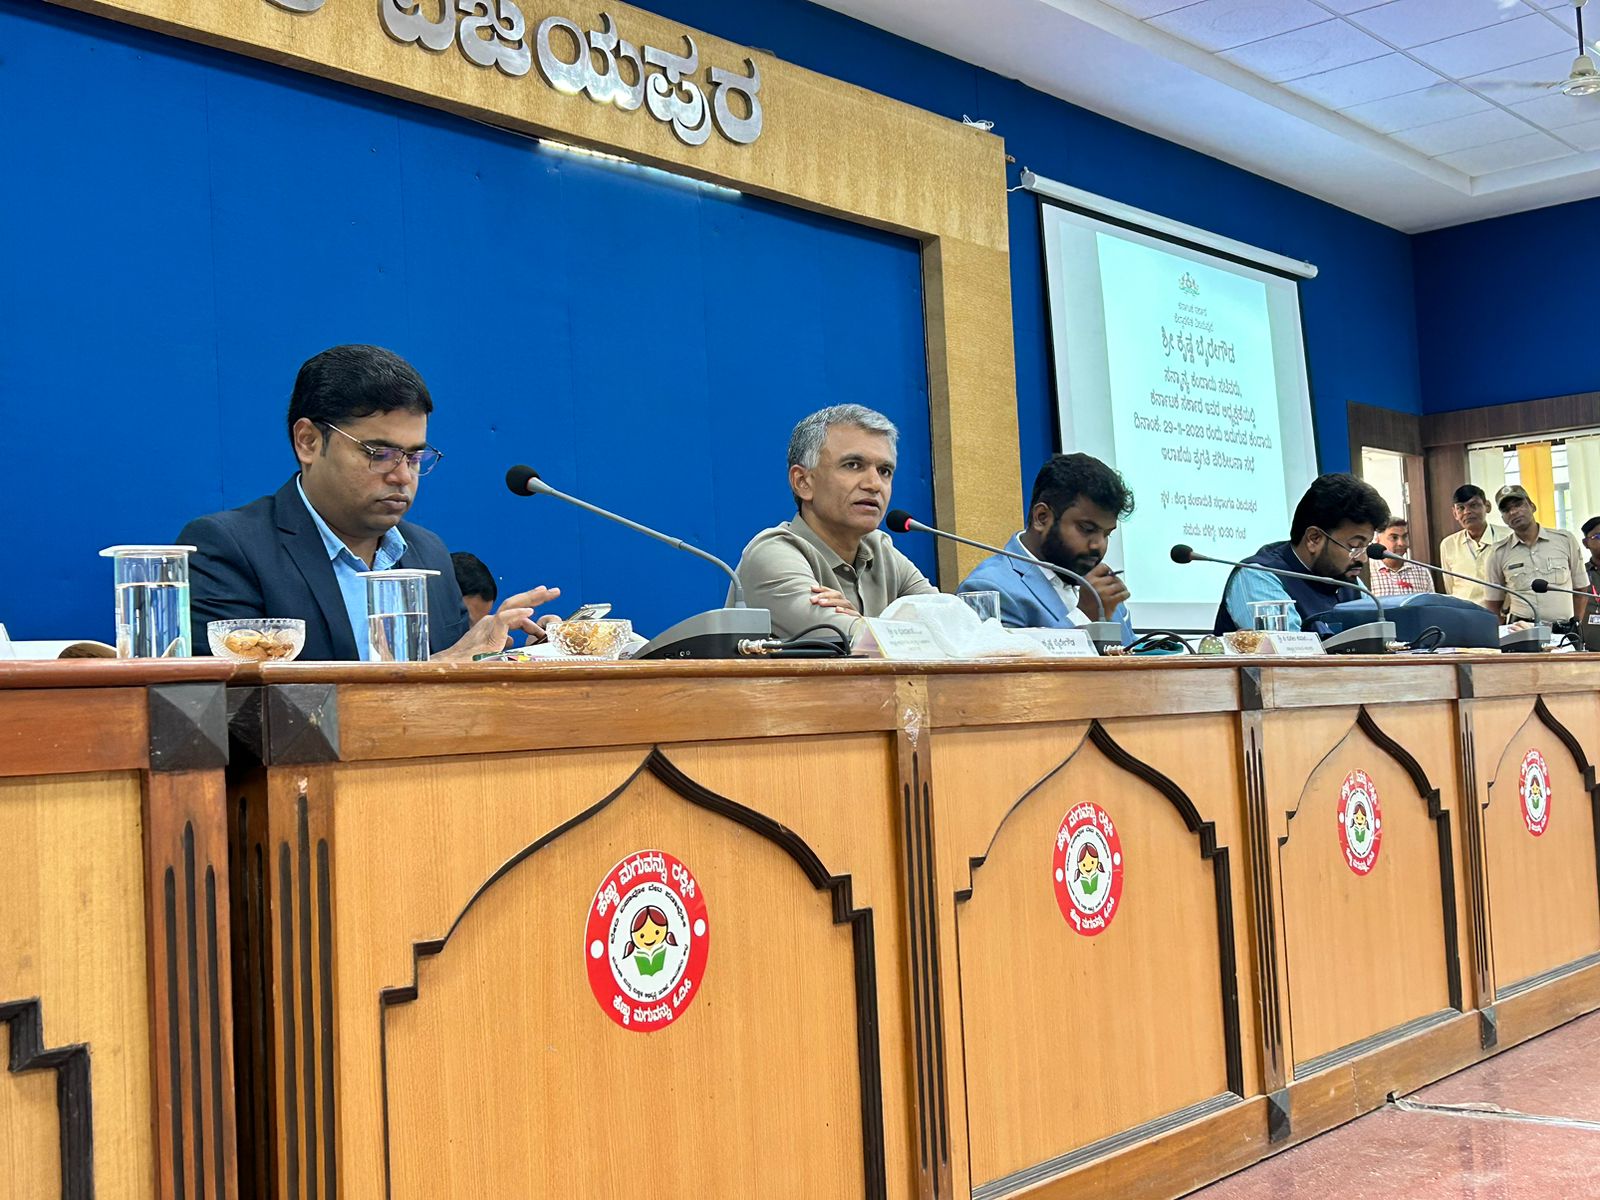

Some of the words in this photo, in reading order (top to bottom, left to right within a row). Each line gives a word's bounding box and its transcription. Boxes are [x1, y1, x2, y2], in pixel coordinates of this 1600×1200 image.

[1161, 325, 1174, 357] ಶ್ರೀ
[1177, 330, 1195, 364] ಕೃಷ್ಣ
[597, 880, 620, 917] ಹೆಣ್ಣು
[618, 852, 668, 885] ಮಗುವನ್ನು
[672, 863, 695, 898] ರಕ್ಷಿಸಿ
[613, 994, 631, 1025] ಹೆಣ್ಣು
[633, 1002, 673, 1023] ಮಗುವನ್ನು
